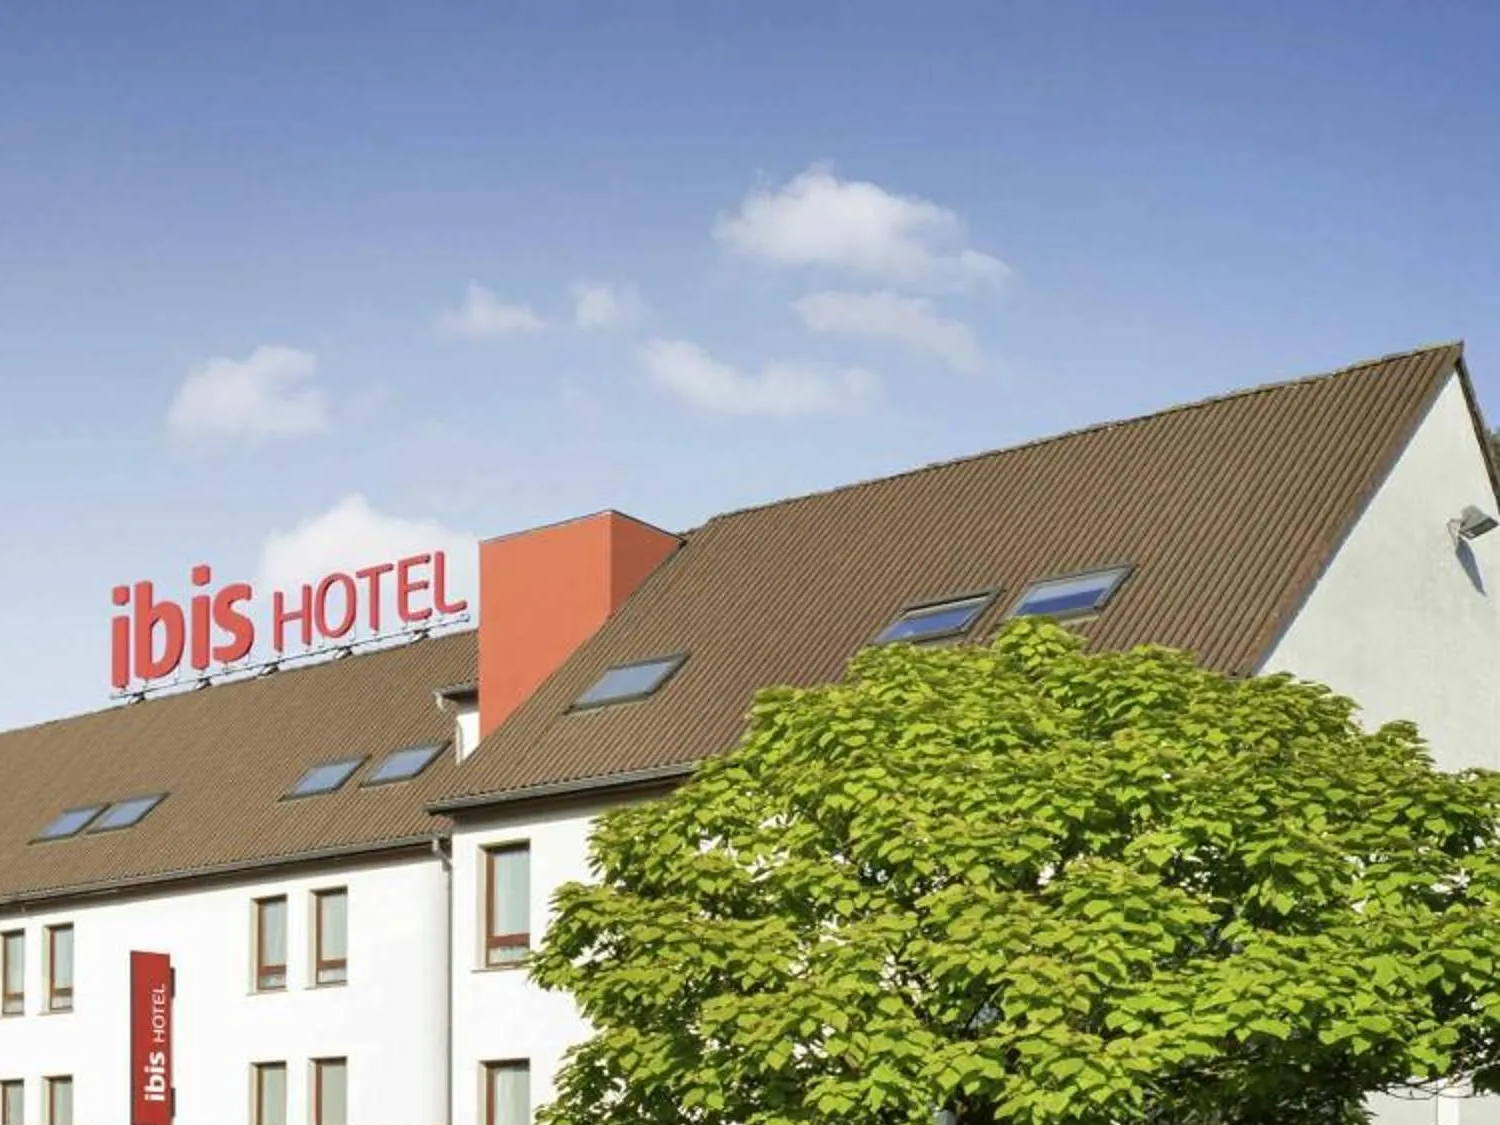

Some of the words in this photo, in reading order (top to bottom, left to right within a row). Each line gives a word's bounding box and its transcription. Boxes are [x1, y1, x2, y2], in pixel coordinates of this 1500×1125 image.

[112, 564, 255, 690] ibis
[273, 551, 468, 654] HOTEL
[151, 983, 166, 1043] HOTEL
[143, 1051, 165, 1102] ibis
